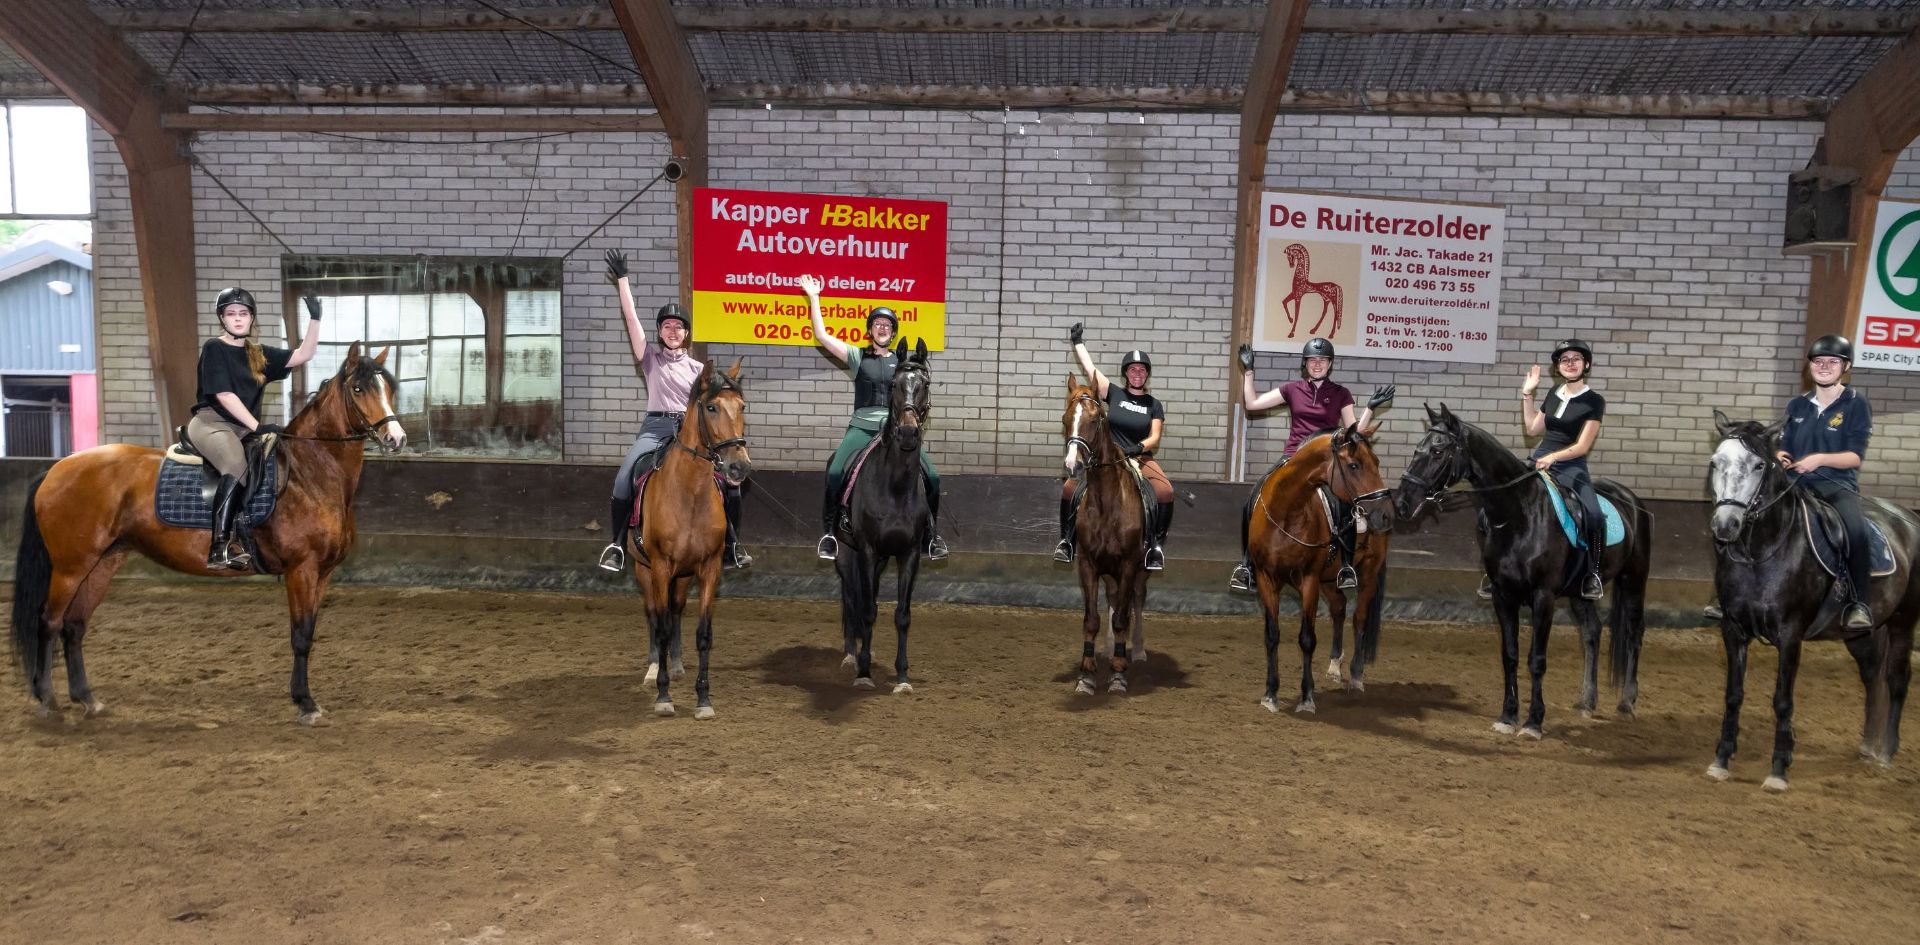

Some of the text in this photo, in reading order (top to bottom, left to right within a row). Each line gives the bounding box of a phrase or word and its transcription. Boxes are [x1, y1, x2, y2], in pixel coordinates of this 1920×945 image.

[711, 197, 809, 227] Kapper
[1269, 204, 1491, 241] De Ruiterzolder
[737, 228, 909, 260] Autoverhuur
[1371, 244, 1493, 263] Mr. Jac. Takade 21
[1370, 261, 1491, 279] 1432 CB Aalsmeer
[828, 276, 876, 291] delen
[880, 277, 916, 293] 24/7
[1385, 277, 1475, 293] 020 496 73 55
[1367, 312, 1450, 327] Openingstijden:
[1366, 325, 1380, 335] Di.
[1383, 327, 1400, 336] t/m
[1404, 328, 1417, 337] Vr.
[1421, 329, 1449, 339] 12:00
[1459, 331, 1488, 341] 18:30
[1365, 338, 1382, 348] Za.
[1386, 339, 1415, 349] 10:00
[1425, 341, 1453, 351] 17:00
[1861, 351, 1890, 362] SPAR
[1893, 354, 1913, 365] City
